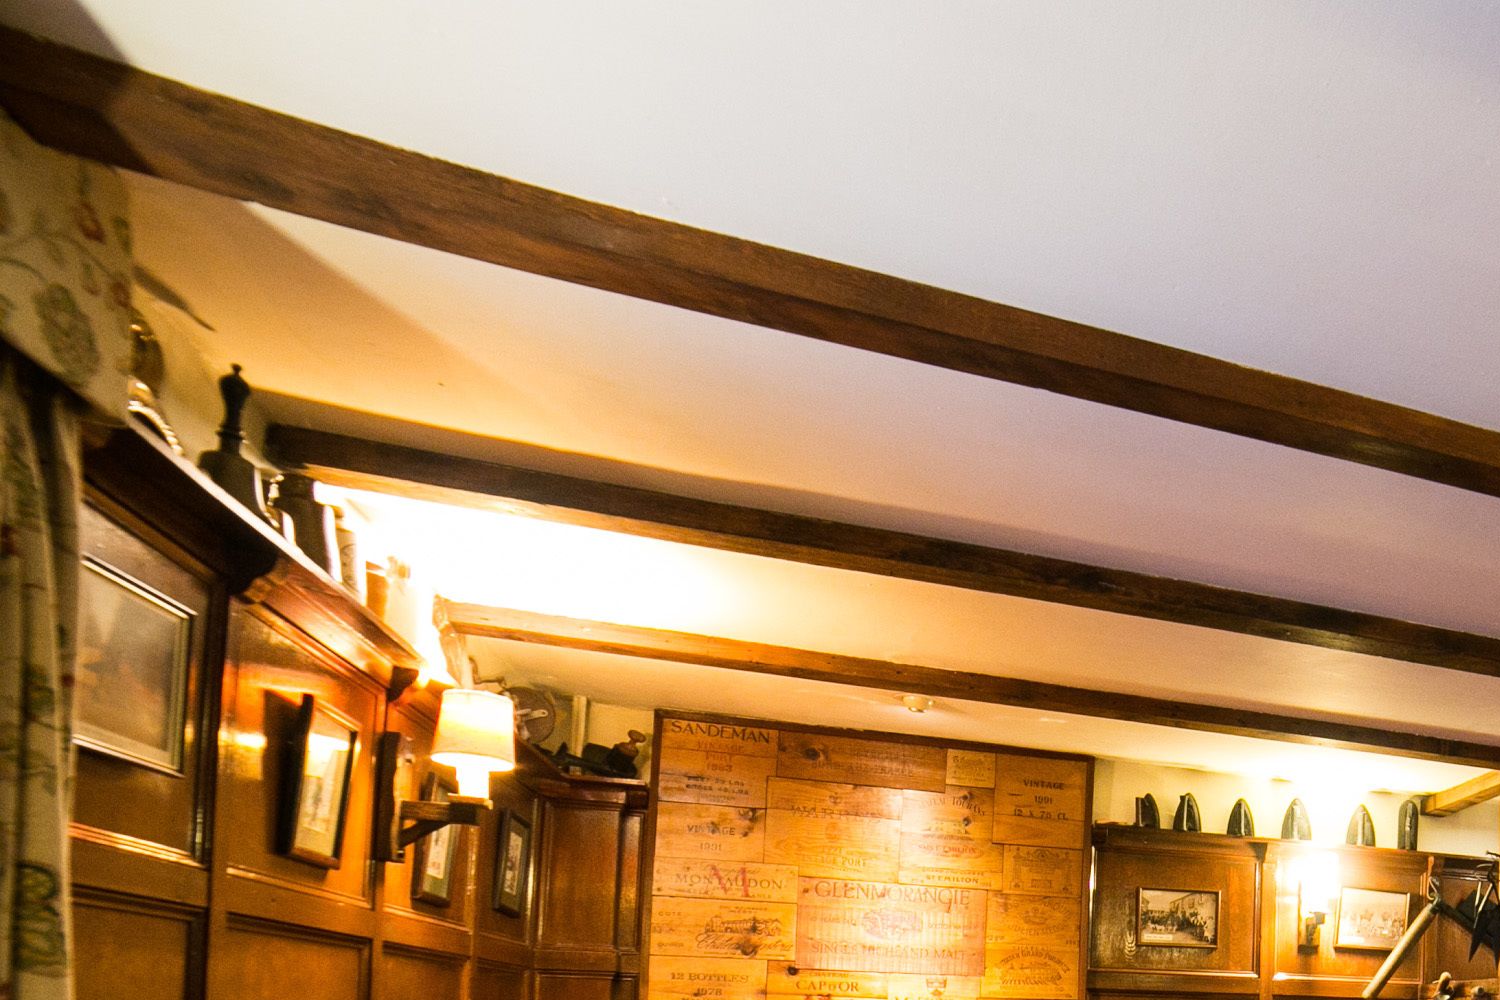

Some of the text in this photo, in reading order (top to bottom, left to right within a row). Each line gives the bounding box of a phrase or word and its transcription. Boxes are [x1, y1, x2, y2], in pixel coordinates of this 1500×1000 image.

[671, 720, 770, 744] SANDEMAN
[1022, 779, 1064, 790] VINTAGE
[1034, 795, 1053, 804] 1991
[687, 824, 736, 836] VINTAGE
[938, 875, 979, 884] EMILION
[814, 880, 970, 906] GLENMORANGIE
[812, 943, 857, 955] SINGLE
[934, 948, 965, 961] MALT
[670, 972, 749, 983] 12 BOTTLES
